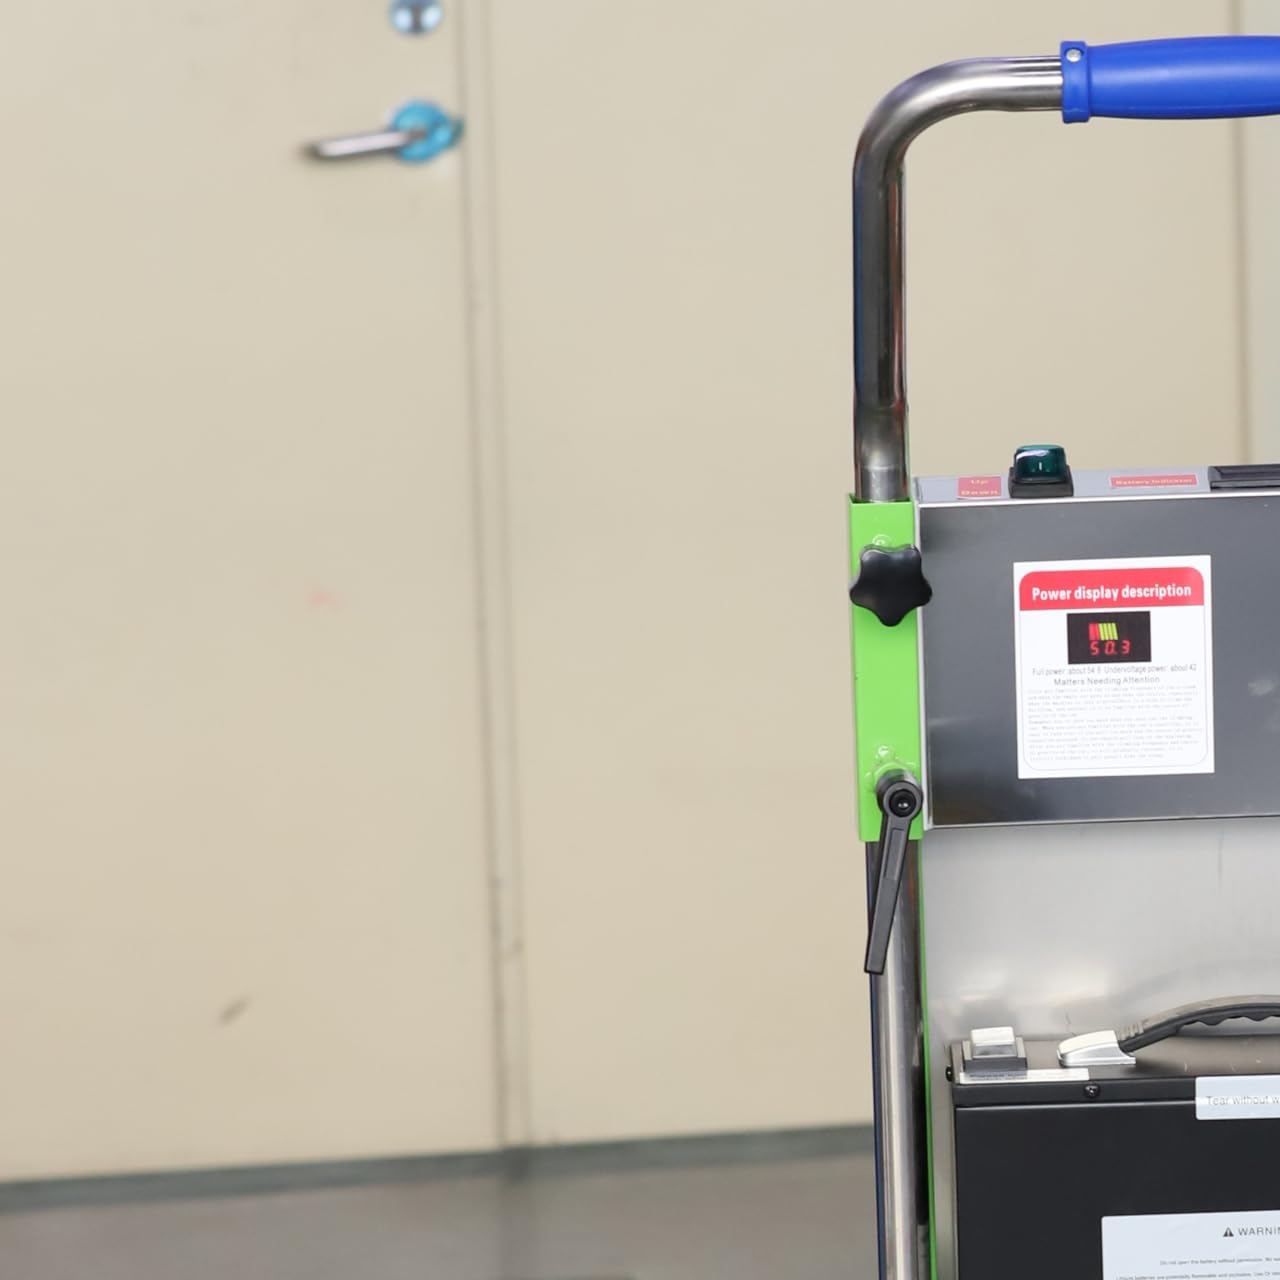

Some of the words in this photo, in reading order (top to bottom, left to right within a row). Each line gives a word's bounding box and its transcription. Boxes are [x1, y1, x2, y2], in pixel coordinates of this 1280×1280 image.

[1032, 587, 1072, 601] Power
[1074, 585, 1119, 602] display
[1122, 583, 1192, 600] description
[1054, 678, 1085, 686] Matters
[1087, 677, 1121, 686] Needing
[1122, 675, 1160, 684] Attention
[1206, 1096, 1229, 1106] Tear
[1232, 1095, 1269, 1105] without
